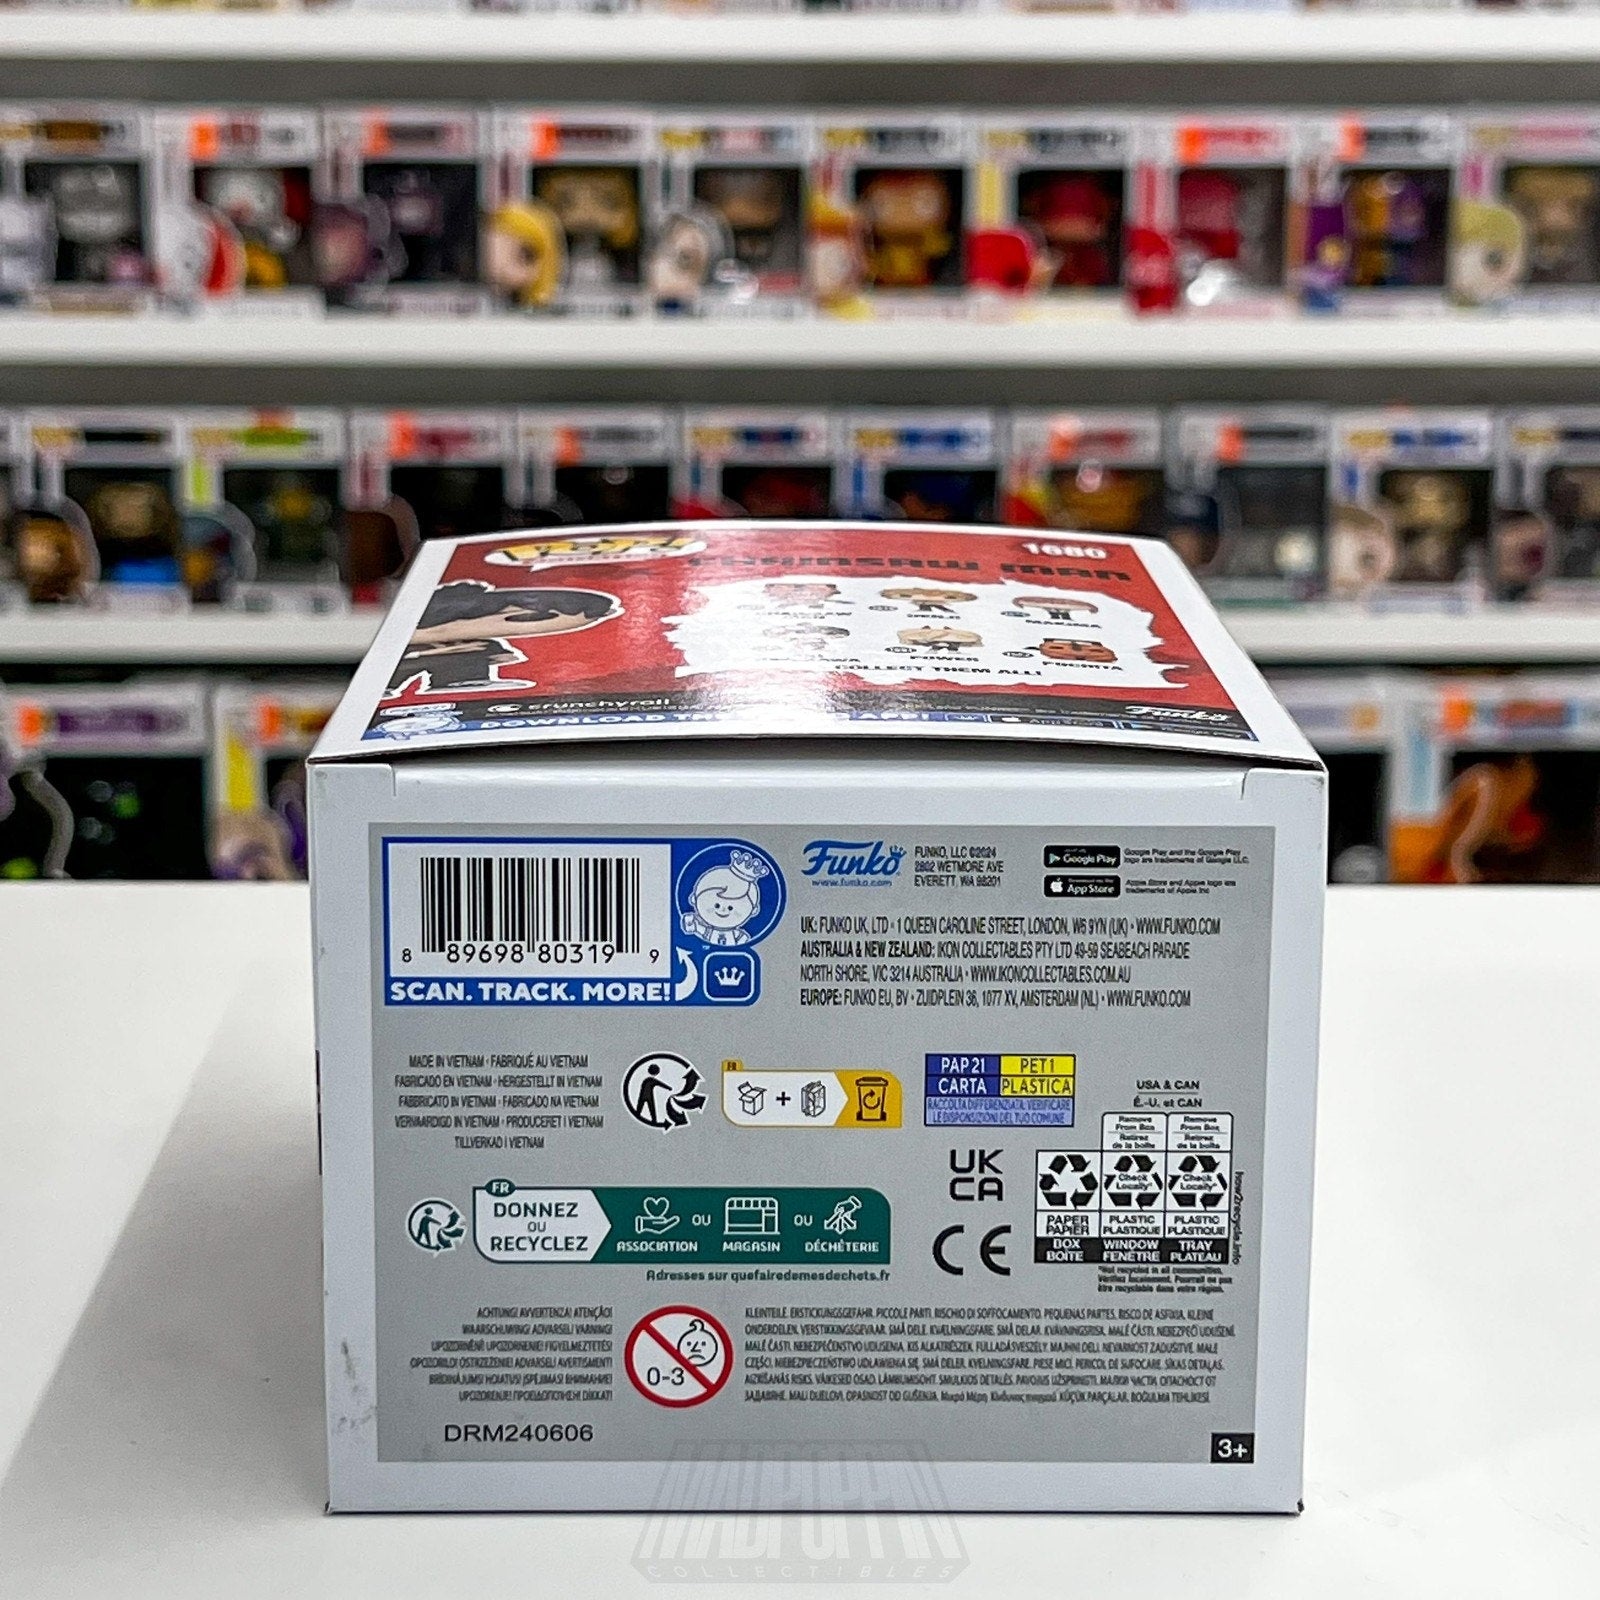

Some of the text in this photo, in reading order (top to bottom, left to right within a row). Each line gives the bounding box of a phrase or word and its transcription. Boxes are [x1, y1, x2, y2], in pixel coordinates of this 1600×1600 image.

[1021, 540, 1107, 560] 1680
[835, 663, 1042, 676] COLLECT THEM ALL!
[480, 713, 667, 730] DOWNLOAD
[801, 840, 907, 876] Funko
[1062, 853, 1117, 866] Google Play
[1067, 885, 1115, 895] App Store
[820, 916, 852, 934] FUNKO
[854, 917, 868, 934] UK,
[872, 916, 888, 934] LTD
[898, 917, 901, 934] 1
[904, 916, 937, 934] QUEEN
[939, 917, 986, 934] CAROLINE
[988, 917, 1025, 934] STREET,
[1089, 918, 1107, 934] 9YN
[1109, 918, 1128, 937] (UK)
[1136, 918, 1220, 934] WWW.FUNKO.COM
[402, 943, 660, 963] 8 89698 80319 9
[801, 941, 853, 958] AUSTRALIA
[856, 941, 862, 958] &
[865, 941, 886, 957] NEW
[888, 941, 935, 958] ZEALAND:
[938, 941, 960, 958] IKON
[962, 941, 1032, 958] COLLECTABLES
[1035, 941, 1053, 958] PTY
[1055, 942, 1072, 958] LTD
[1100, 942, 1150, 959] SEABEACH
[1153, 942, 1190, 959] PARADE
[800, 964, 833, 982] NORTH
[873, 964, 887, 982] VIC
[890, 966, 910, 982] 3214
[913, 965, 963, 982] AUSTRALIA
[390, 981, 671, 1002] SCAN. TRACK. MORE!
[800, 989, 842, 1006] EUROPE:
[844, 989, 876, 1006] FUNKO
[878, 989, 893, 1006] EU,
[896, 989, 908, 1006] BV
[916, 989, 964, 1006] ZUIDPLEIN
[983, 990, 1002, 1006] 1077
[1005, 990, 1018, 1007] XV,
[1020, 990, 1078, 1006] AMSTERDAM
[1081, 990, 1098, 1009] (NL)
[1107, 990, 1190, 1007] WWW.FUNKO.COM
[941, 1057, 985, 1074] PAP 21
[1020, 1058, 1055, 1073] PET 1
[938, 1078, 987, 1094] CARTA
[1002, 1078, 1071, 1094] PLASTICA
[1136, 1080, 1200, 1090] USA & CAN
[1163, 1098, 1174, 1108] et
[1177, 1098, 1203, 1108] CAN
[950, 1149, 1003, 1174] UK
[1119, 1173, 1147, 1182] Check
[1183, 1173, 1212, 1182] Check
[491, 1182, 509, 1194] FR
[950, 1177, 1003, 1201] CA
[493, 1202, 579, 1218] DONNEZ
[693, 1215, 711, 1226] OU
[794, 1215, 813, 1226] OU
[1047, 1215, 1089, 1225] PAPER
[1109, 1215, 1155, 1224] PLASTIC
[1174, 1215, 1220, 1224] PLASTIC
[527, 1221, 546, 1233] OU
[1046, 1225, 1089, 1235] PAPIER
[1103, 1226, 1160, 1235] PLASTIQUE
[1168, 1226, 1225, 1235] PLASTIQUE
[490, 1235, 589, 1252] RECYCLEZ
[616, 1241, 698, 1252] ASSOCIATION
[722, 1241, 780, 1252] MAGASIN
[1053, 1239, 1081, 1249] BOX
[1104, 1240, 1159, 1250] WINDOW
[1179, 1241, 1213, 1251] TRAY
[932, 1225, 1012, 1276] CE
[1170, 1252, 1221, 1262] PLATEAU
[646, 1270, 891, 1284] Adresses sur quefairedemesdechets.fr
[646, 1367, 685, 1386] 0-3
[444, 1424, 594, 1443] DRM240606
[1217, 1438, 1248, 1458] 3+
